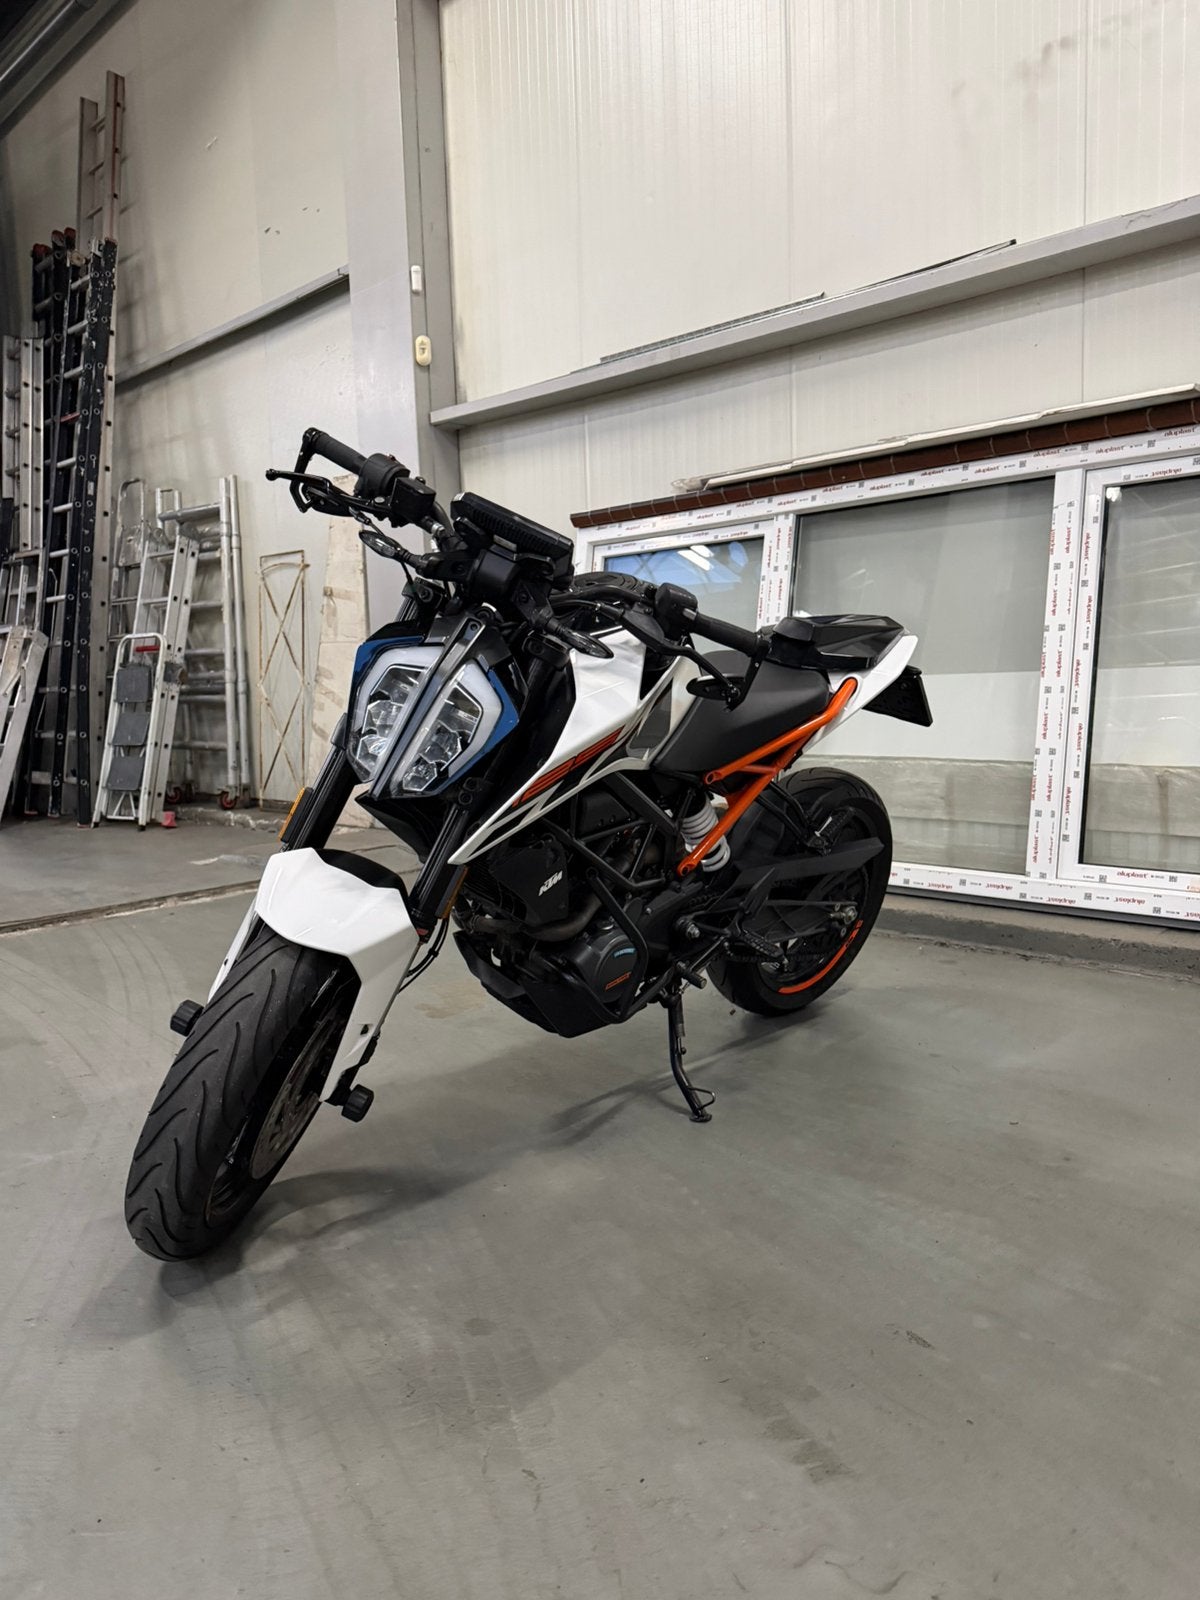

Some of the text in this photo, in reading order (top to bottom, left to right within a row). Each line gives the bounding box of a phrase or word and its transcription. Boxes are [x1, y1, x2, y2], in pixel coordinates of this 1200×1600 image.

[1117, 870, 1148, 880] aluplast
[538, 870, 563, 896] KTM
[1046, 896, 1077, 905] aluplast
[1113, 897, 1146, 905] aluplast
